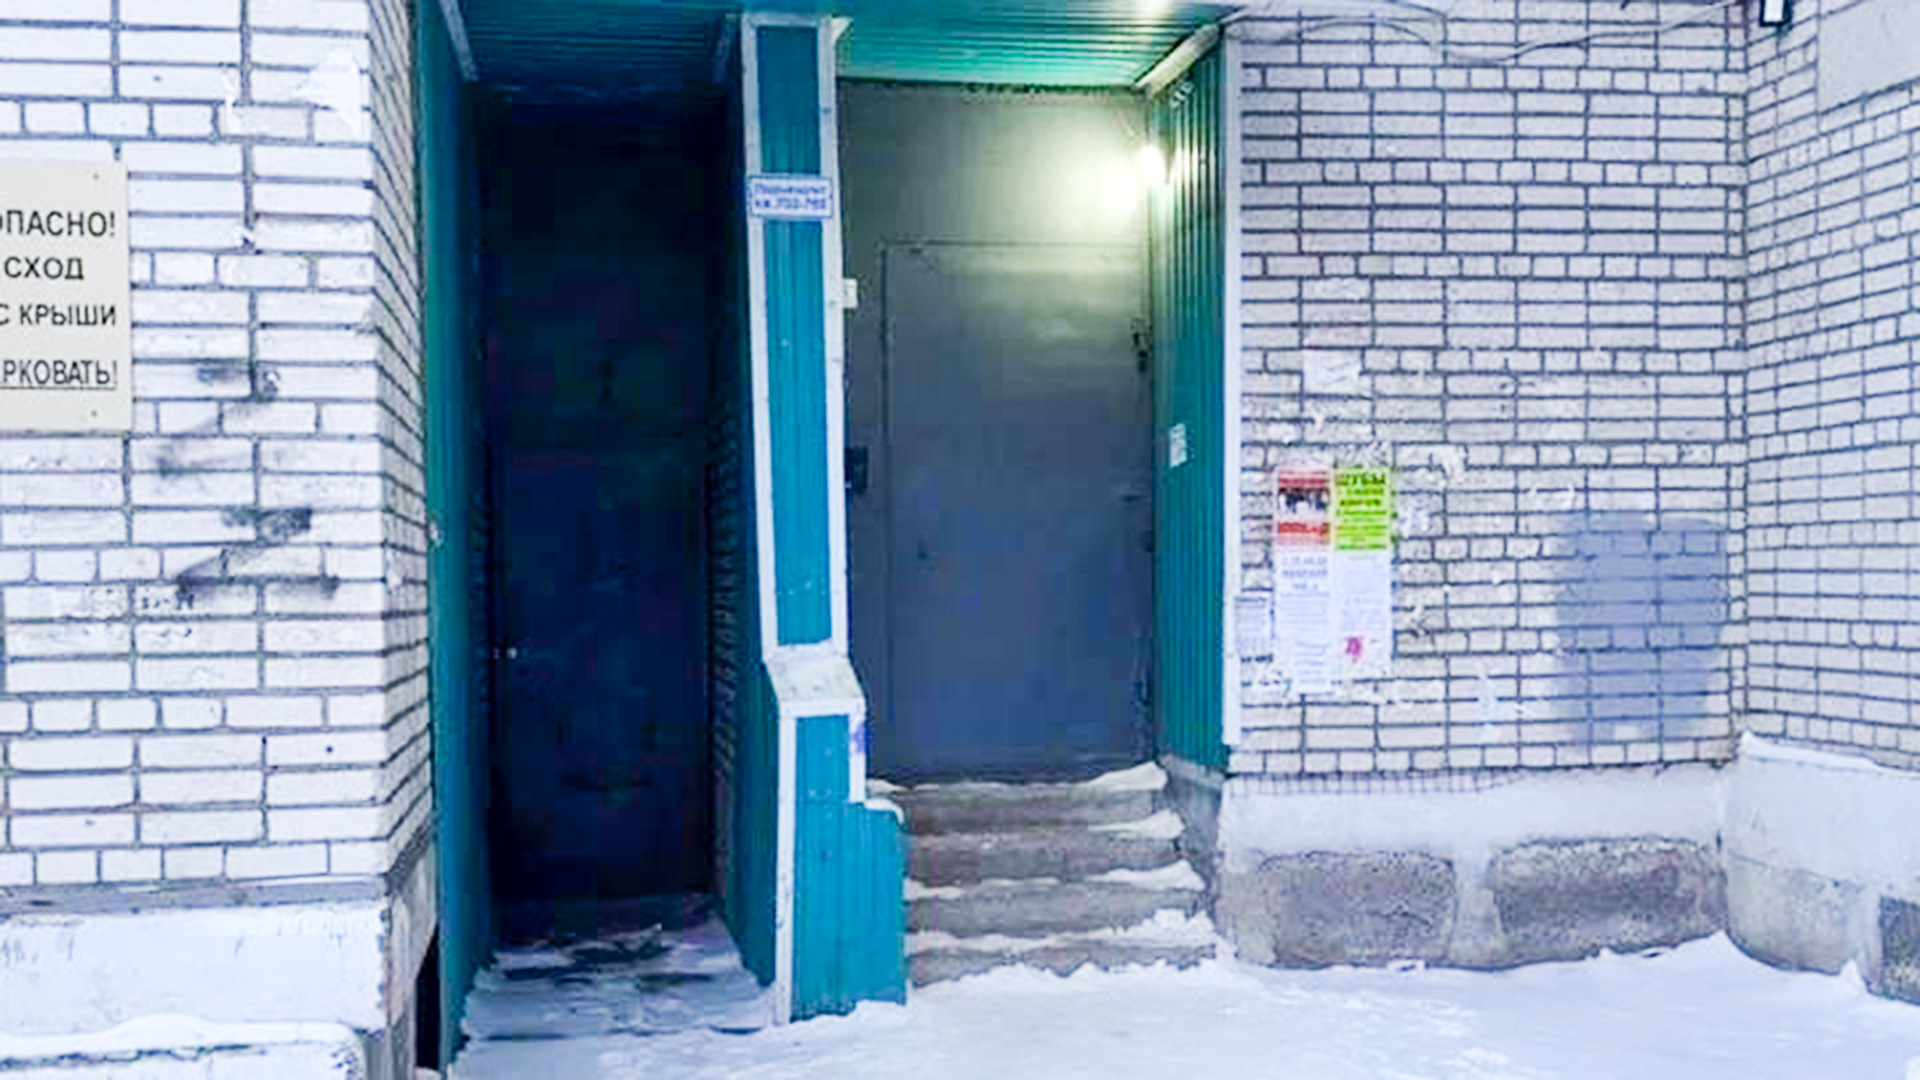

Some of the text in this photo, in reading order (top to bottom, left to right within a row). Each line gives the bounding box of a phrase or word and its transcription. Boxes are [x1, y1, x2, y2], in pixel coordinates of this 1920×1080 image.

[0, 210, 115, 237] ПАСНО!
[3, 256, 84, 280] СХОД
[19, 304, 117, 326] КРЫШИ
